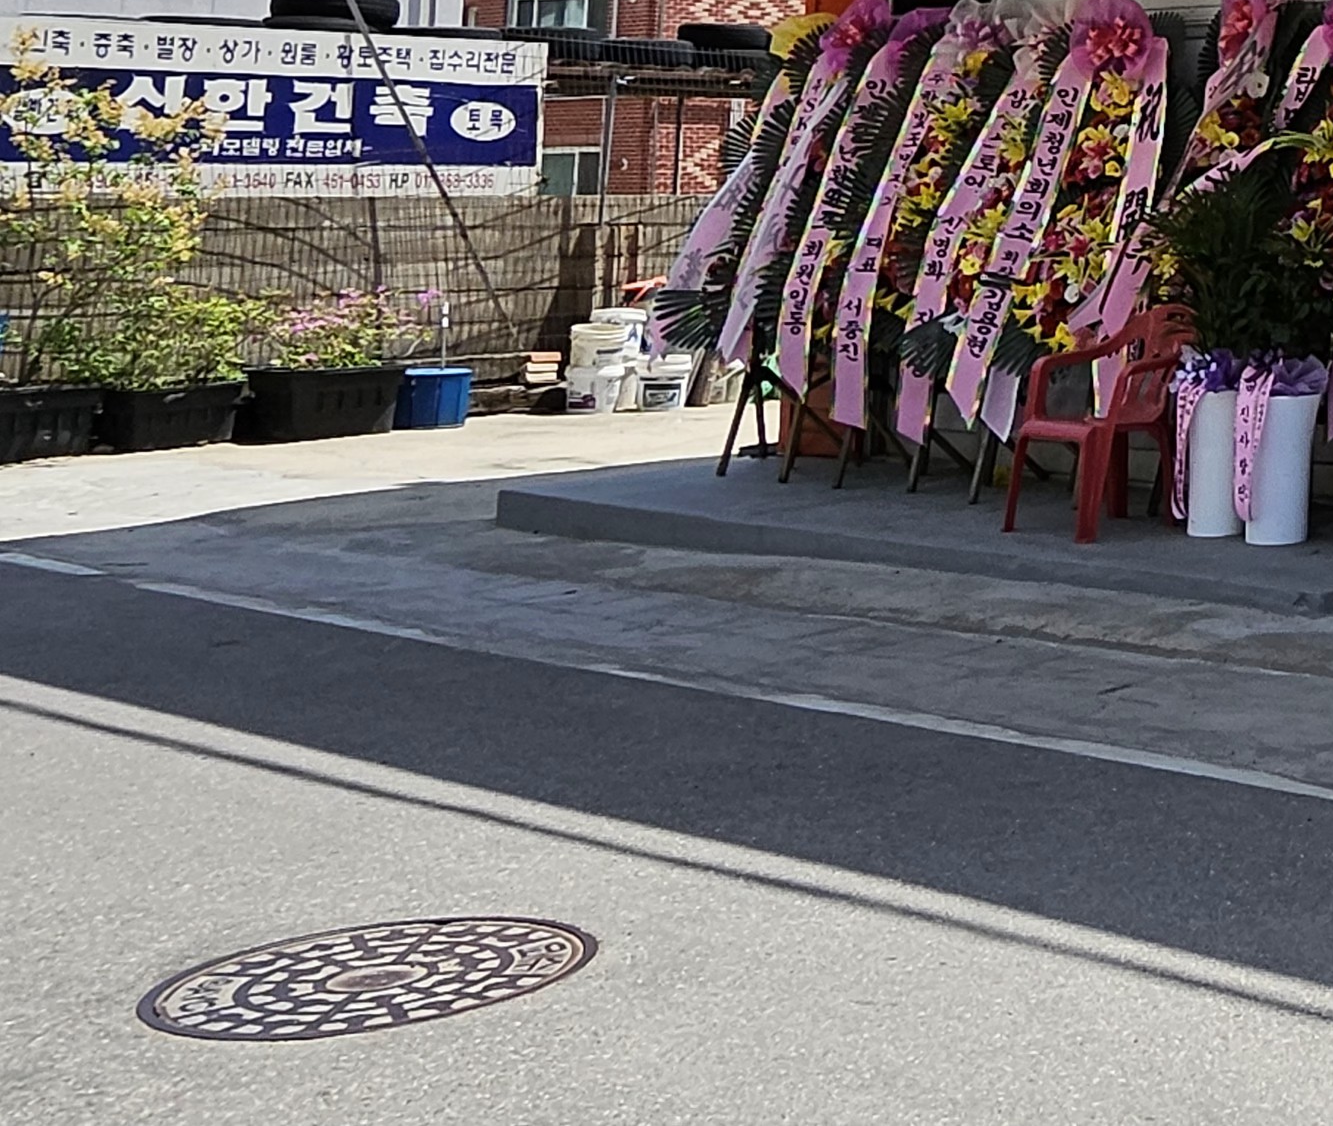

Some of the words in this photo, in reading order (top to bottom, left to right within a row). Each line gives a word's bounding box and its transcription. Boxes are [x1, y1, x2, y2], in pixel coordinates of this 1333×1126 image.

[93, 33, 134, 58] 증축
[156, 35, 197, 62] 별장
[219, 39, 261, 64] 상가
[281, 42, 317, 67] 원룸
[336, 44, 412, 70] 황토주택
[429, 49, 516, 75] 집수리전문
[467, 108, 504, 132] 토목
[284, 172, 314, 188] FAX
[389, 173, 409, 188] HP
[1004, 87, 1080, 244] 인제청년회의소
[967, 288, 1007, 359] 김용현
